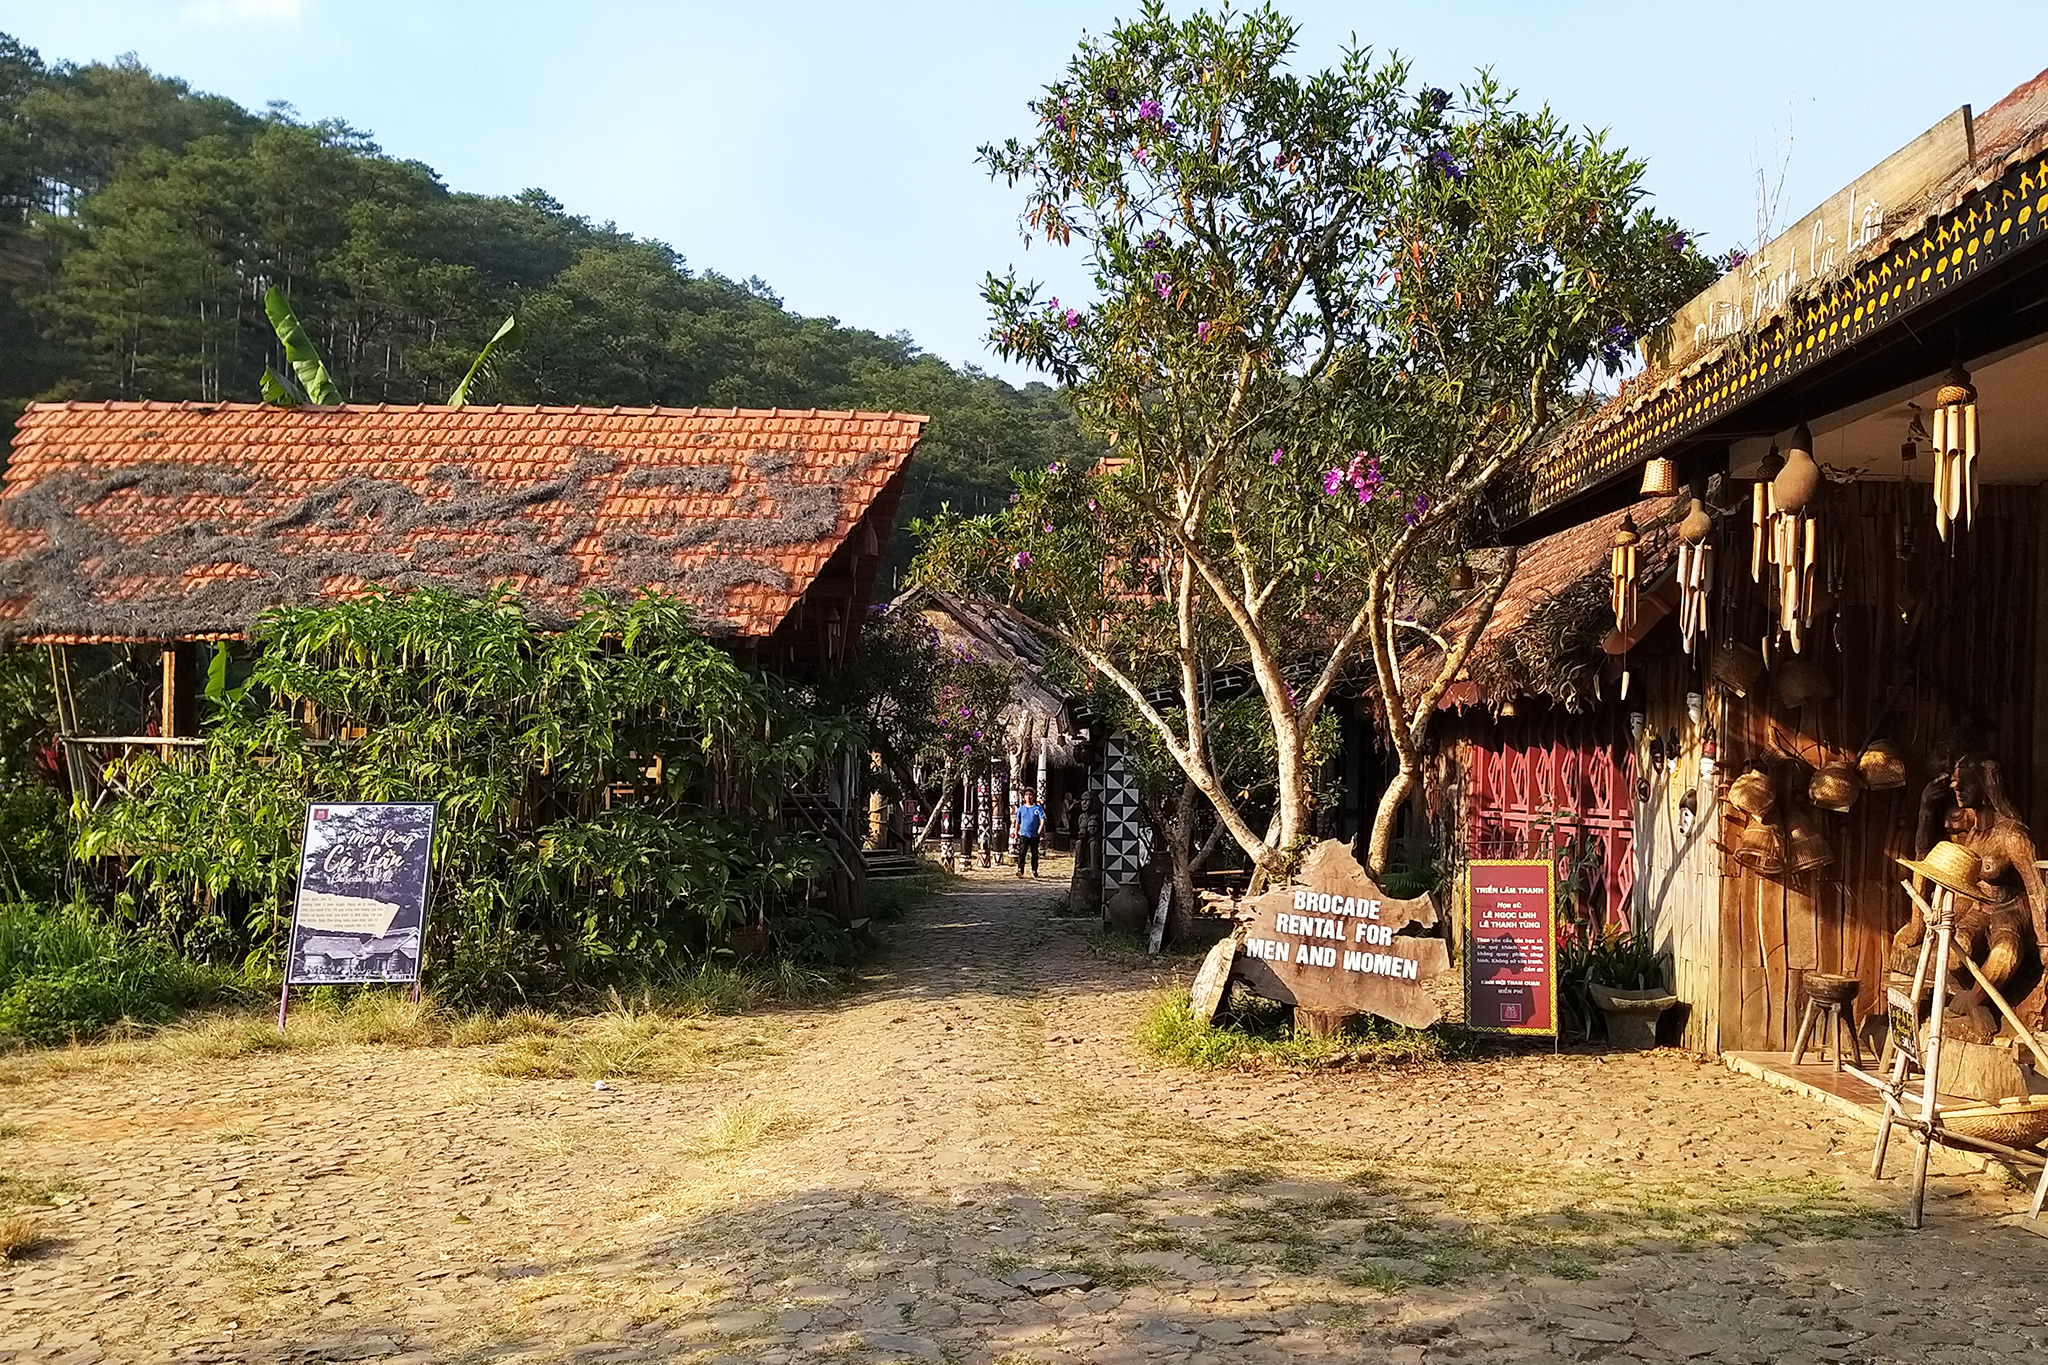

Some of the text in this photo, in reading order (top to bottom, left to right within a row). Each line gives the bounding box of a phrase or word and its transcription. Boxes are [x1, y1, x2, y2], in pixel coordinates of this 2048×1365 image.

[323, 844, 357, 873] Cù
[1499, 886, 1516, 894] LÃM
[1293, 890, 1381, 920] BROCADE
[1482, 910, 1493, 919] LÊ
[1276, 913, 1393, 947] RENTAL FOR
[1479, 920, 1489, 928] LÊ
[1518, 920, 1541, 928] TÙNG
[1246, 938, 1418, 980] MEN AND WOMEN
